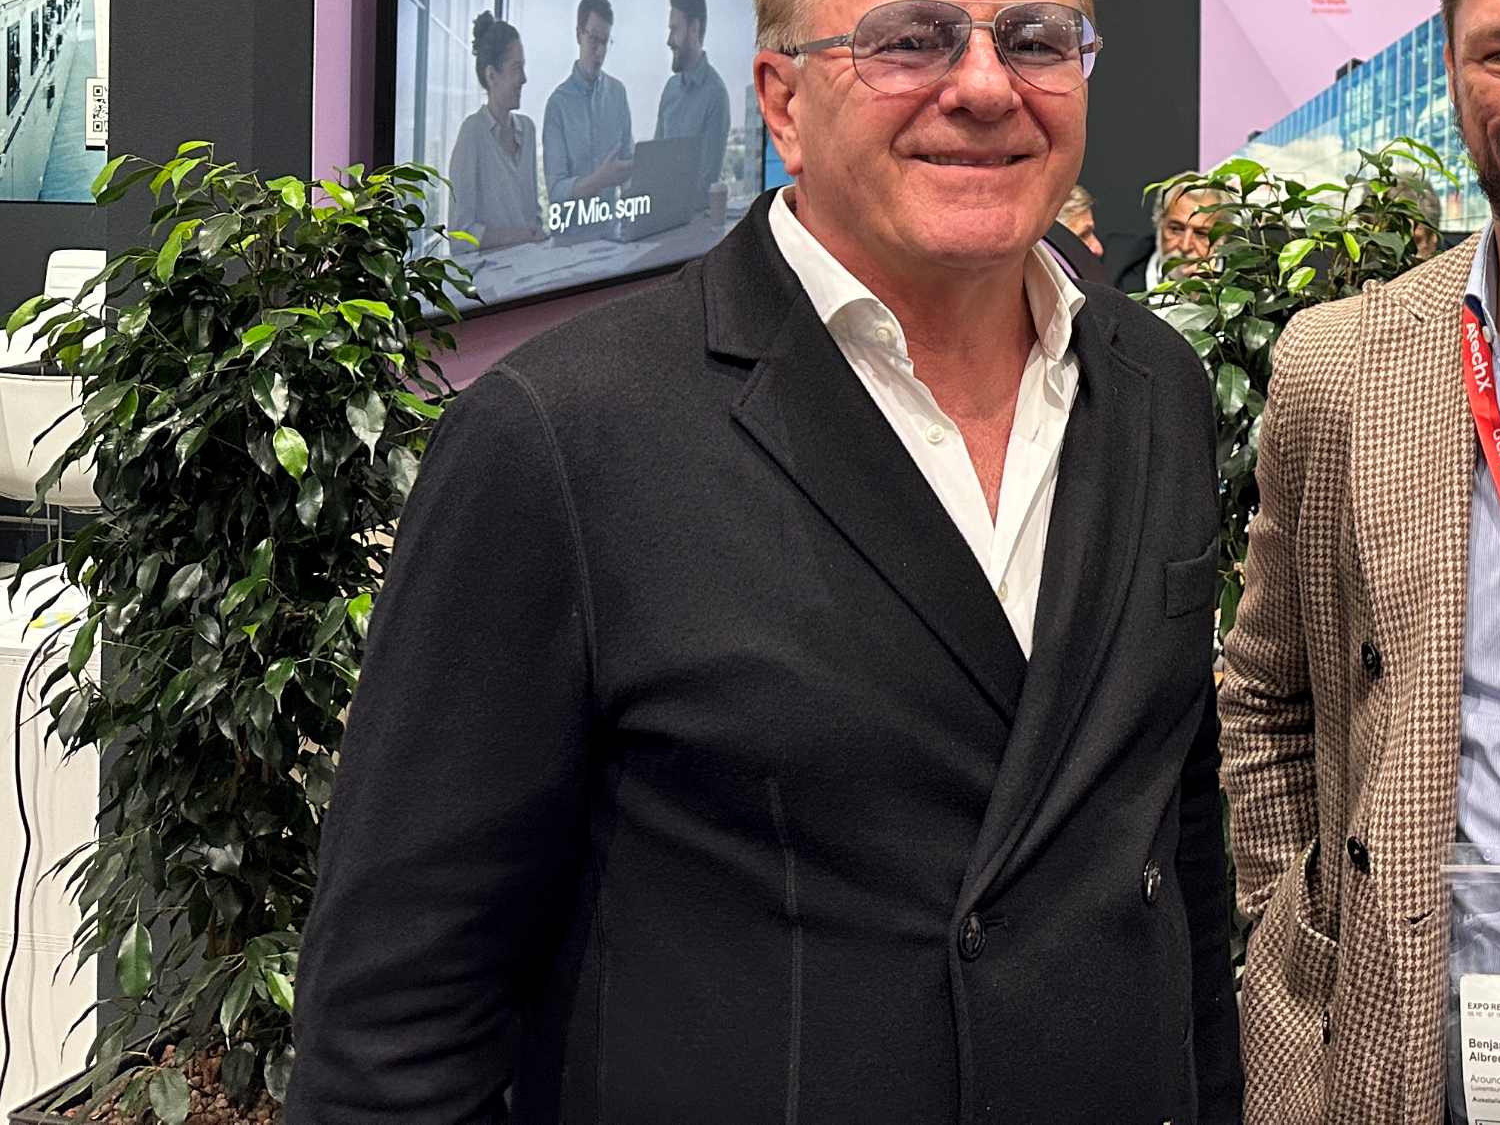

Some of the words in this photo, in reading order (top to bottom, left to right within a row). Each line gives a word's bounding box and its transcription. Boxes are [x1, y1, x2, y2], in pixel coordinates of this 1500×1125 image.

[548, 200, 576, 234] 8,7
[577, 196, 613, 226] Mio.
[615, 194, 651, 223] sqm
[1466, 322, 1493, 393] AtechX
[1467, 1002, 1489, 1011] EXPO
